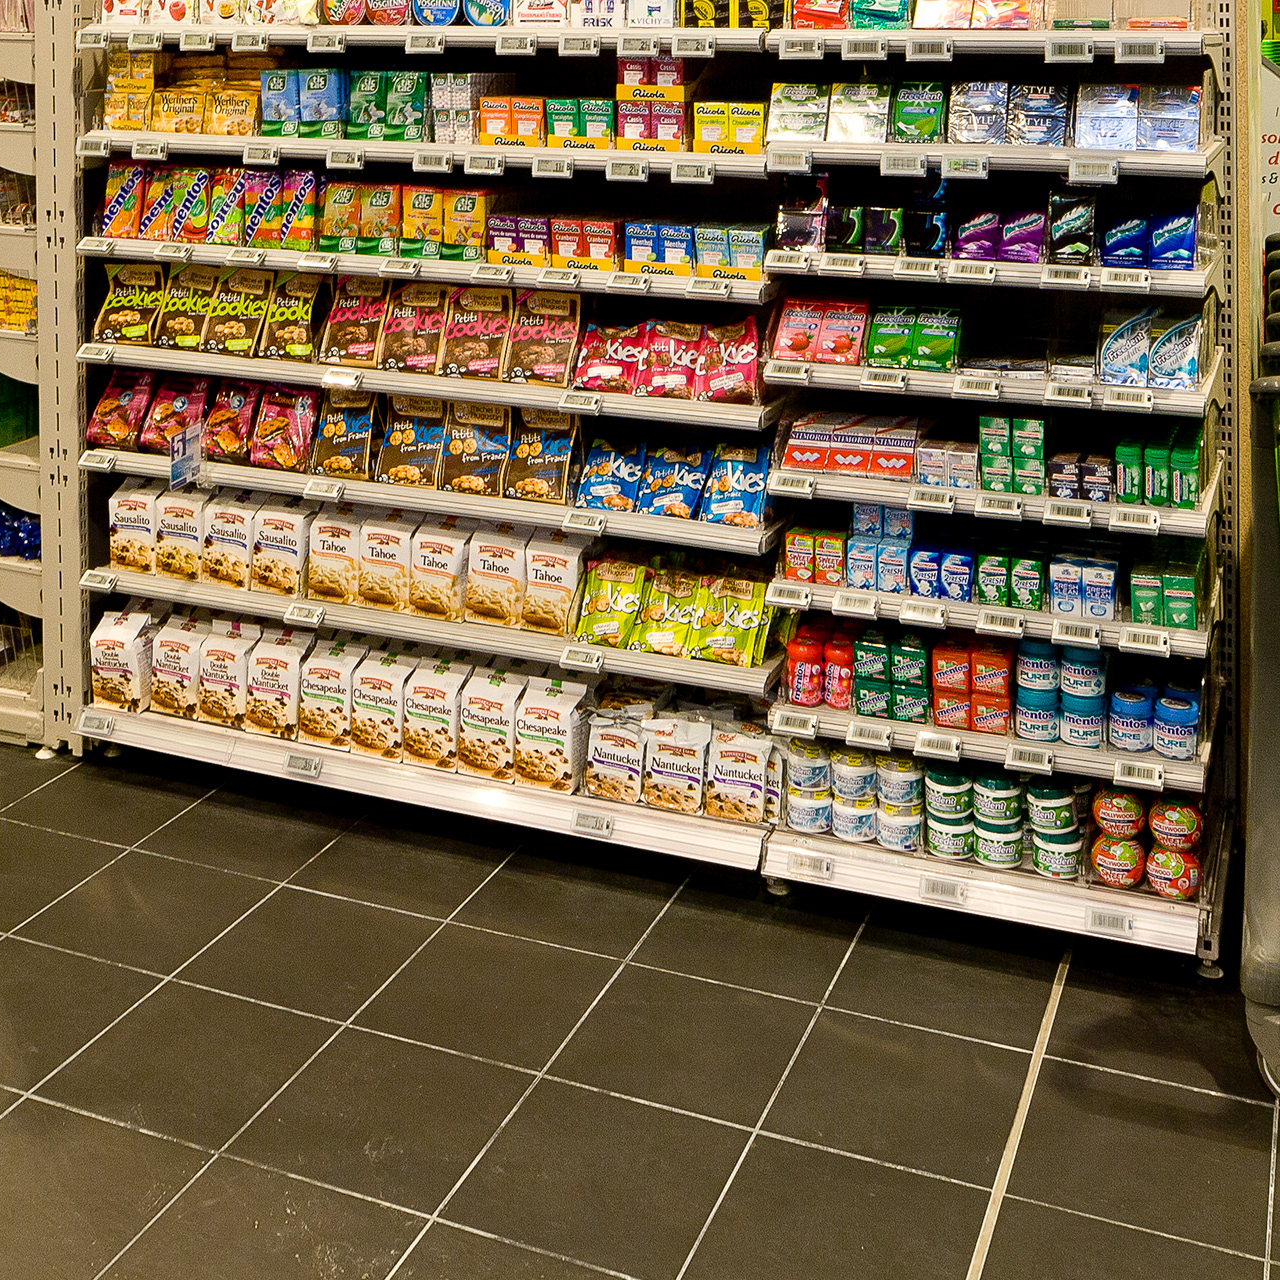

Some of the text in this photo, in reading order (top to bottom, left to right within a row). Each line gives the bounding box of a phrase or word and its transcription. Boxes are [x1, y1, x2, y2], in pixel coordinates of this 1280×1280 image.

[583, 17, 613, 27] FRISK
[270, 82, 284, 91] tac
[309, 82, 323, 90] tac
[1022, 85, 1055, 95] STYLE
[160, 94, 197, 104] Werther's
[633, 89, 665, 99] Ricola
[898, 91, 942, 101] Freedent
[214, 95, 250, 106] Werther's
[162, 104, 195, 114] Original
[214, 105, 247, 116] Original
[633, 142, 665, 152] Ricola
[710, 144, 745, 155] Ricola
[1269, 172, 1278, 184] &
[556, 234, 579, 243] Cranberry
[587, 236, 611, 245] Cranberry
[631, 238, 653, 247] Menthol
[664, 239, 686, 249] Menthol
[501, 255, 532, 266] Ricola
[567, 260, 599, 271] Ricola
[641, 265, 675, 276] Ricola
[115, 287, 135, 296] Petits
[170, 288, 189, 298] Petits
[105, 285, 164, 310] cookies
[219, 293, 240, 303] Petits
[276, 297, 298, 307] Petits
[209, 292, 268, 316] cookies
[329, 296, 386, 324] cookies
[784, 308, 822, 318] Freedent
[826, 309, 865, 320] Freedent
[383, 308, 446, 334] cookies
[1107, 332, 1145, 362] Freedent
[1155, 336, 1193, 366] Freedent
[791, 432, 831, 441] STIMOROL
[833, 435, 874, 445] STIMOROL
[400, 442, 441, 452] from France
[462, 450, 506, 463] from France
[114, 513, 150, 526] Sausalito
[160, 519, 198, 534] Sausalito
[210, 524, 247, 541] Sausalito
[320, 539, 347, 553] Tahoe
[368, 546, 397, 561] Tahoe
[880, 566, 903, 574] 2FRESH
[944, 575, 968, 583] 2FRESH
[102, 651, 119, 659] Double
[163, 652, 181, 661] Double
[855, 654, 887, 668] mentos
[893, 659, 924, 673] mentos
[1018, 658, 1055, 669] mentos
[935, 664, 968, 678] mentos
[974, 669, 1008, 683] mentos
[1021, 671, 1050, 680] PURE
[302, 679, 347, 696] Chesapeake
[1063, 676, 1092, 688] PURE
[354, 688, 398, 708] Chesapeake
[406, 698, 452, 716] Chesapeake
[1020, 722, 1049, 731] PURE
[593, 747, 641, 768] Nantucket
[652, 756, 701, 775] Nantucket
[714, 765, 763, 782] Nantucket
